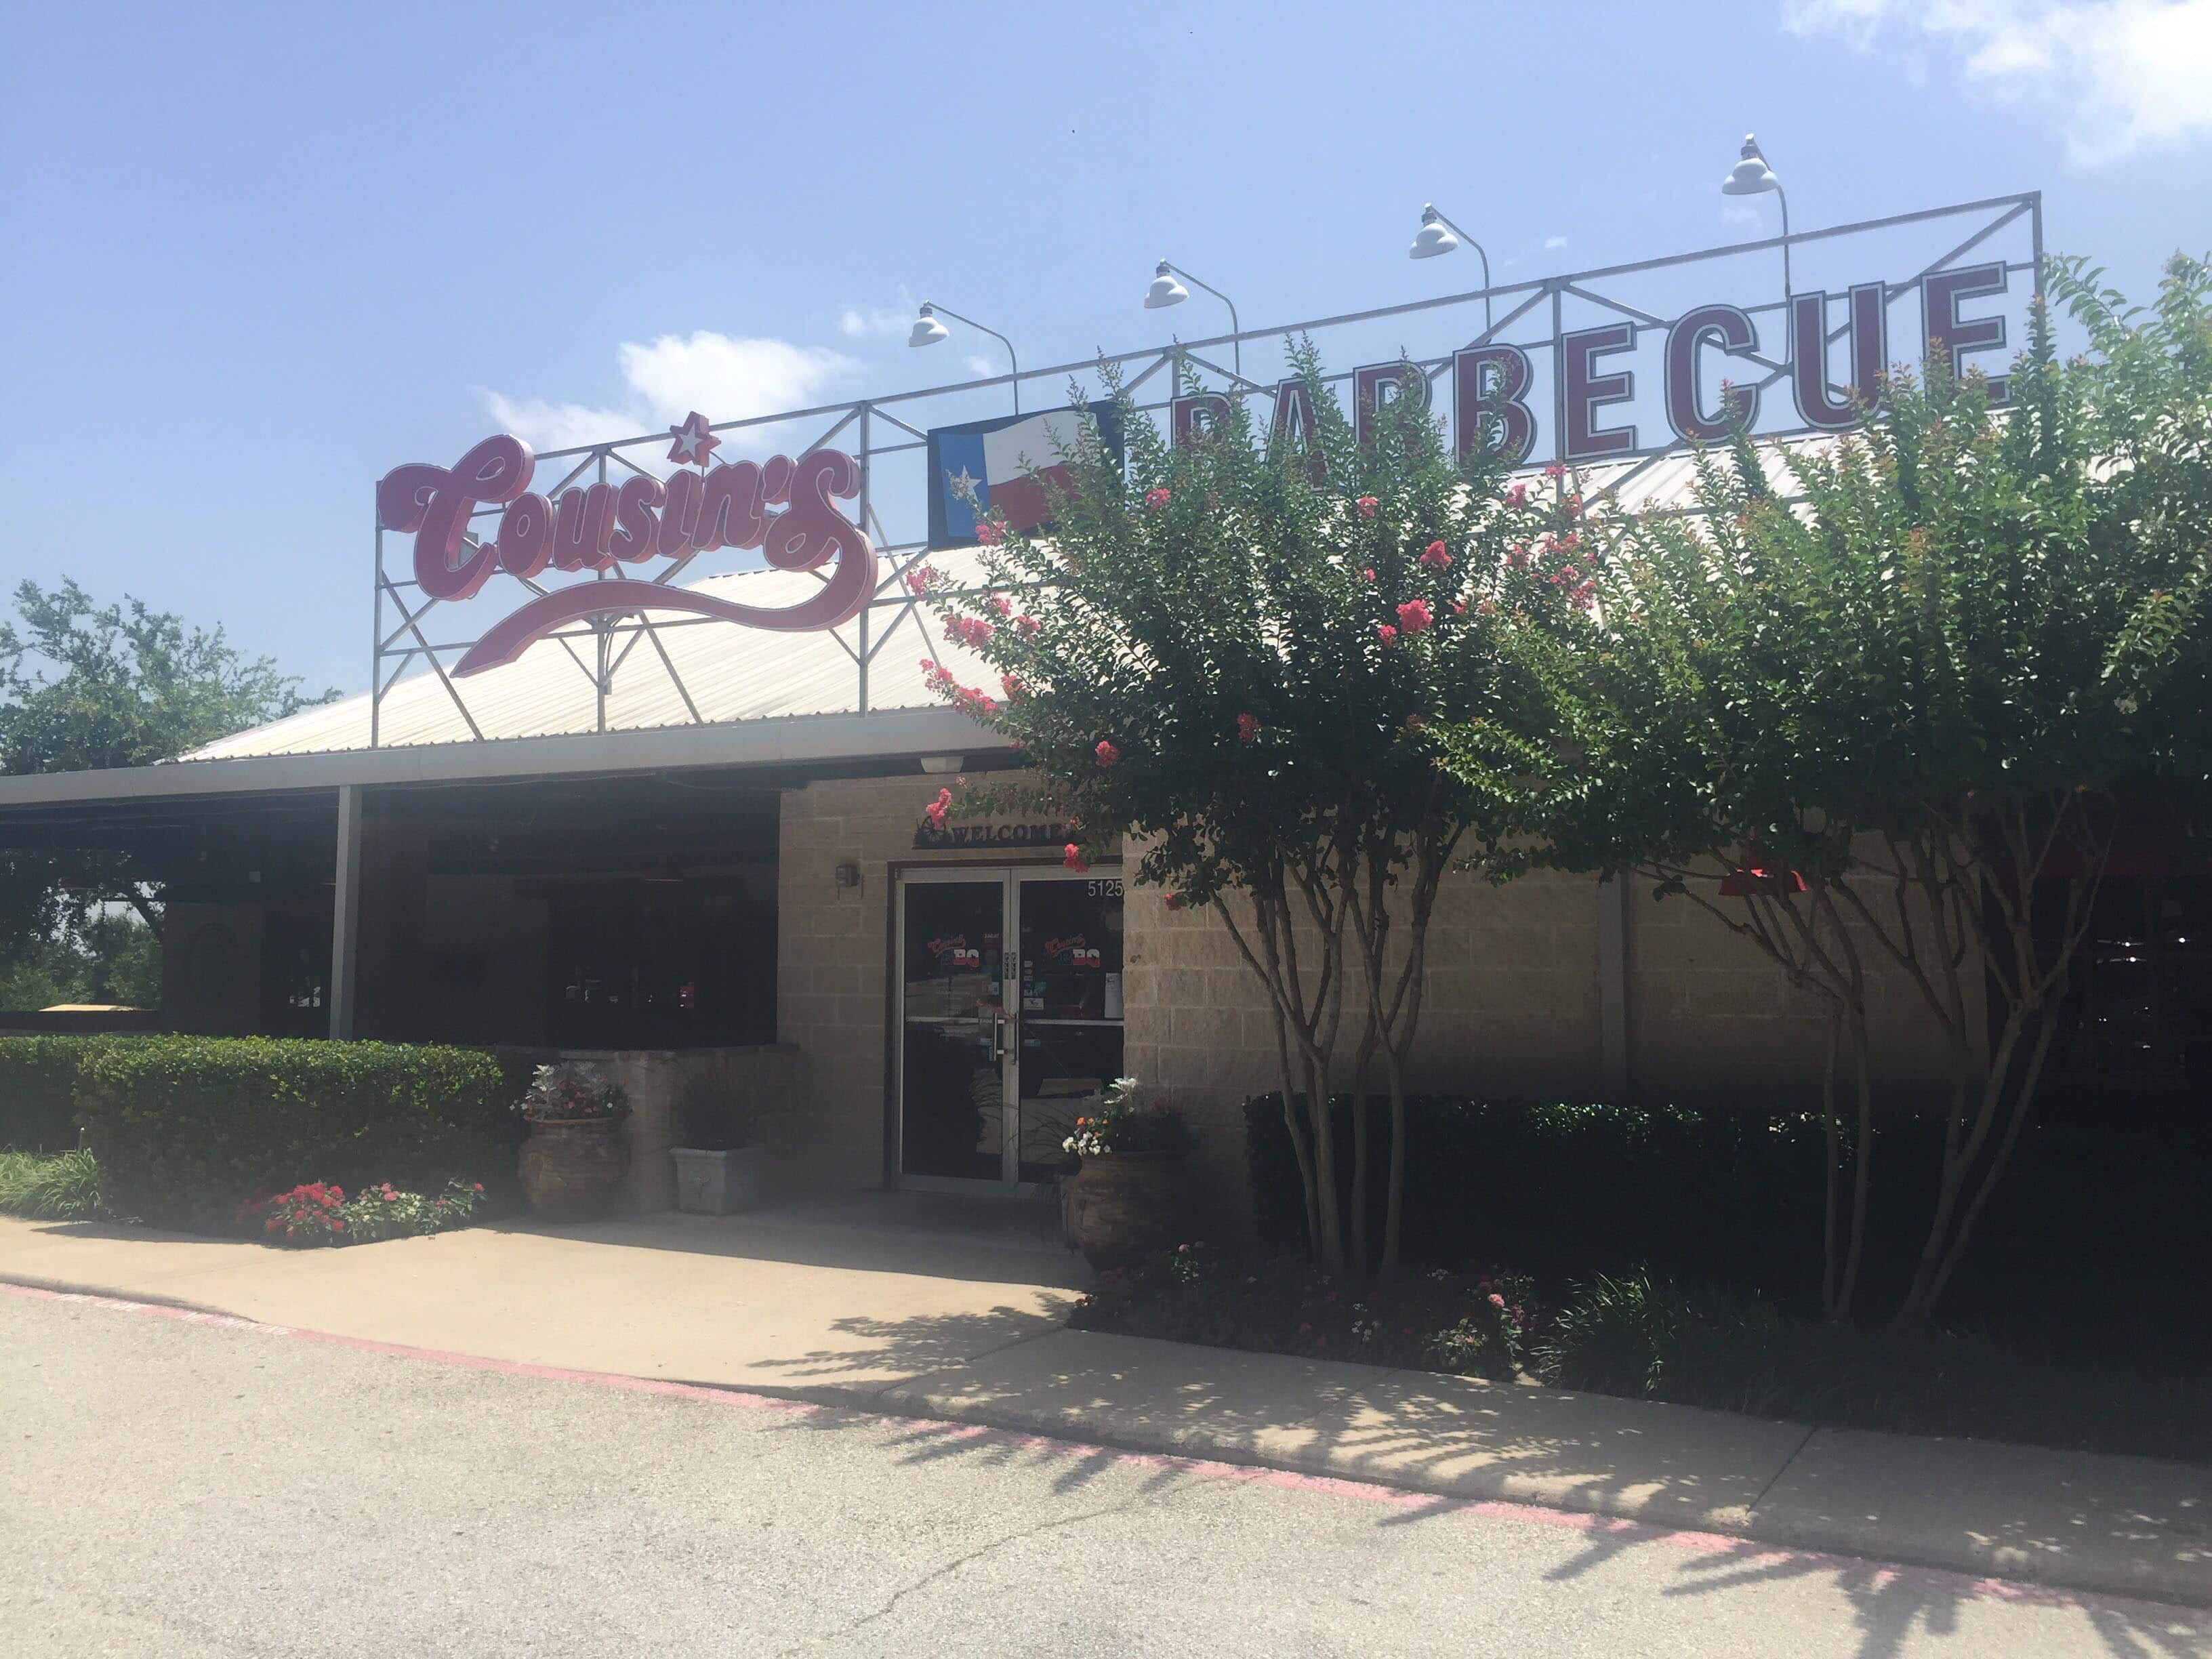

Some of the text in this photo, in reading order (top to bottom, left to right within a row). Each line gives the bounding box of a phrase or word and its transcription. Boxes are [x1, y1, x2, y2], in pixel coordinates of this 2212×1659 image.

[377, 411, 878, 678] Cousin's
[951, 823, 1065, 843] WELCOME
[1088, 880, 1124, 897] 5125
